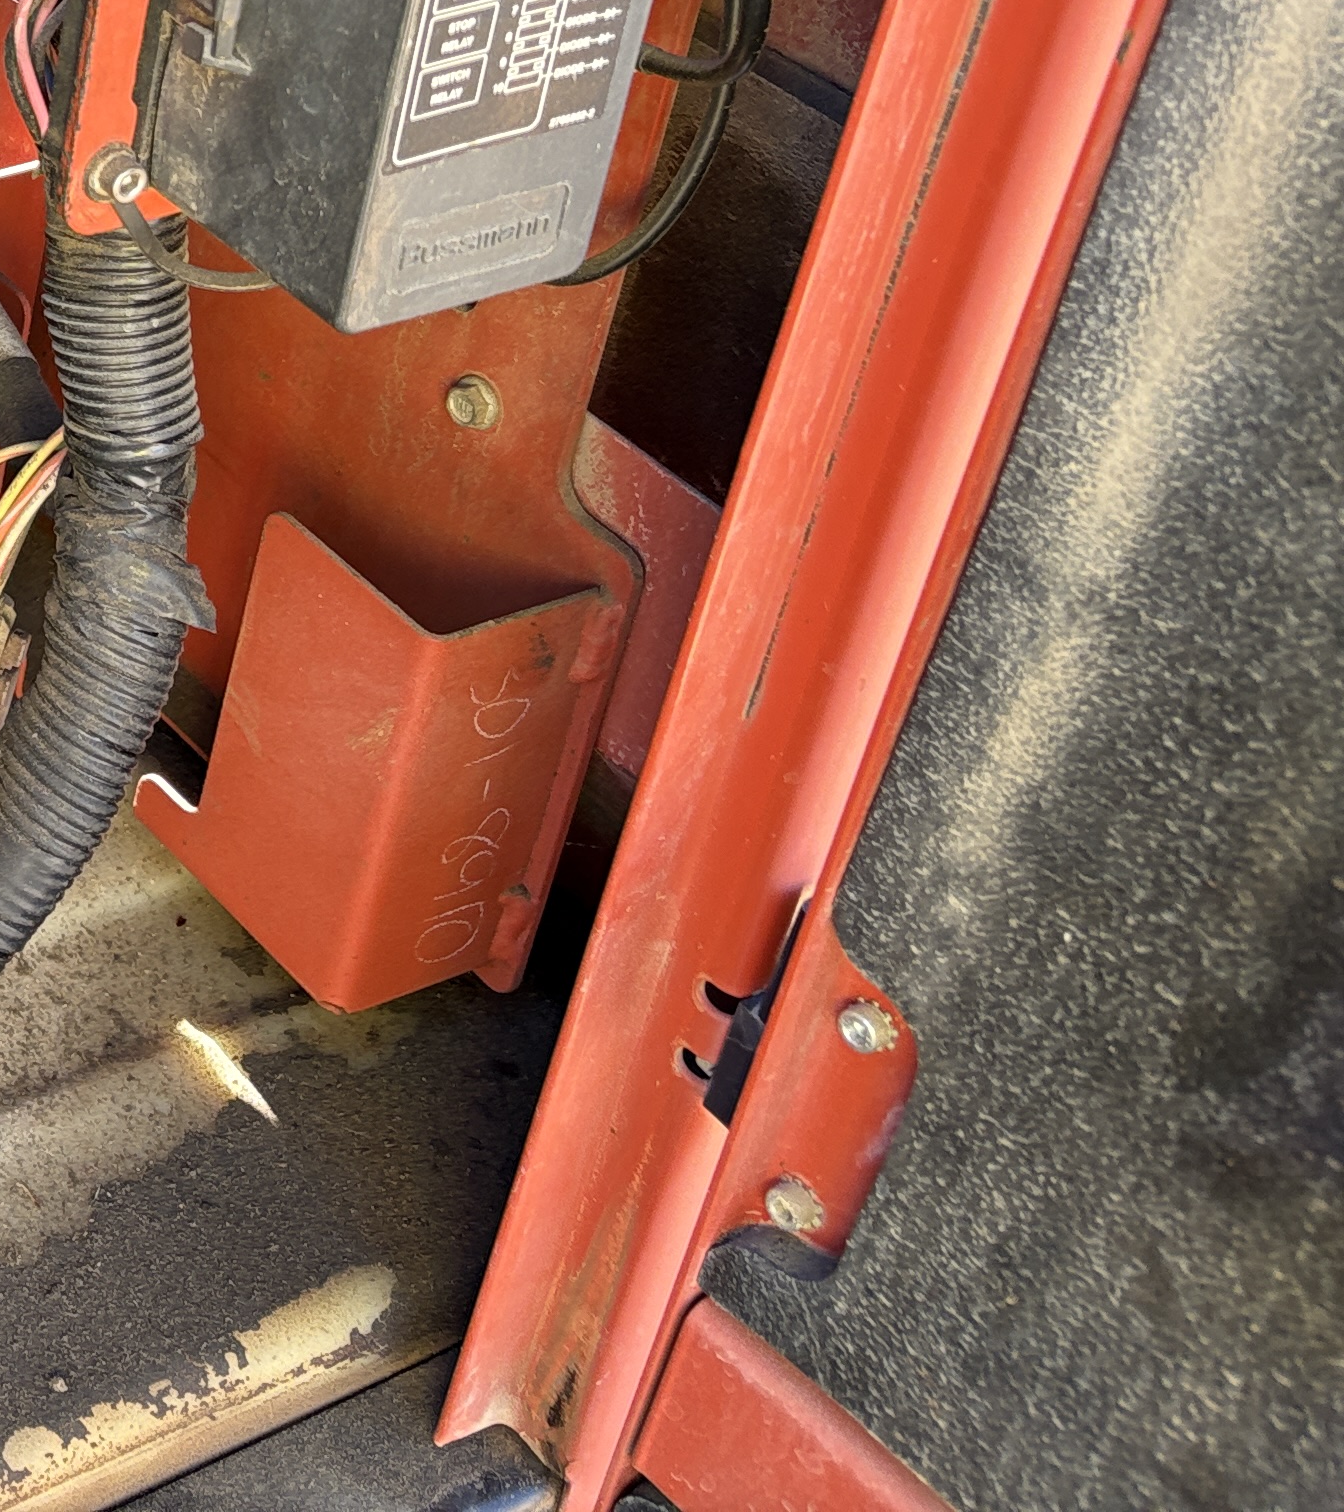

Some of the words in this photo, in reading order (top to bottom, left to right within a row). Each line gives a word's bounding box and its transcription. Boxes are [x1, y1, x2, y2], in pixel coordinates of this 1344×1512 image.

[447, 17, 477, 36] STOP
[440, 35, 475, 55] RELAY
[430, 67, 472, 90] SWITCH
[429, 87, 464, 107] RELAY
